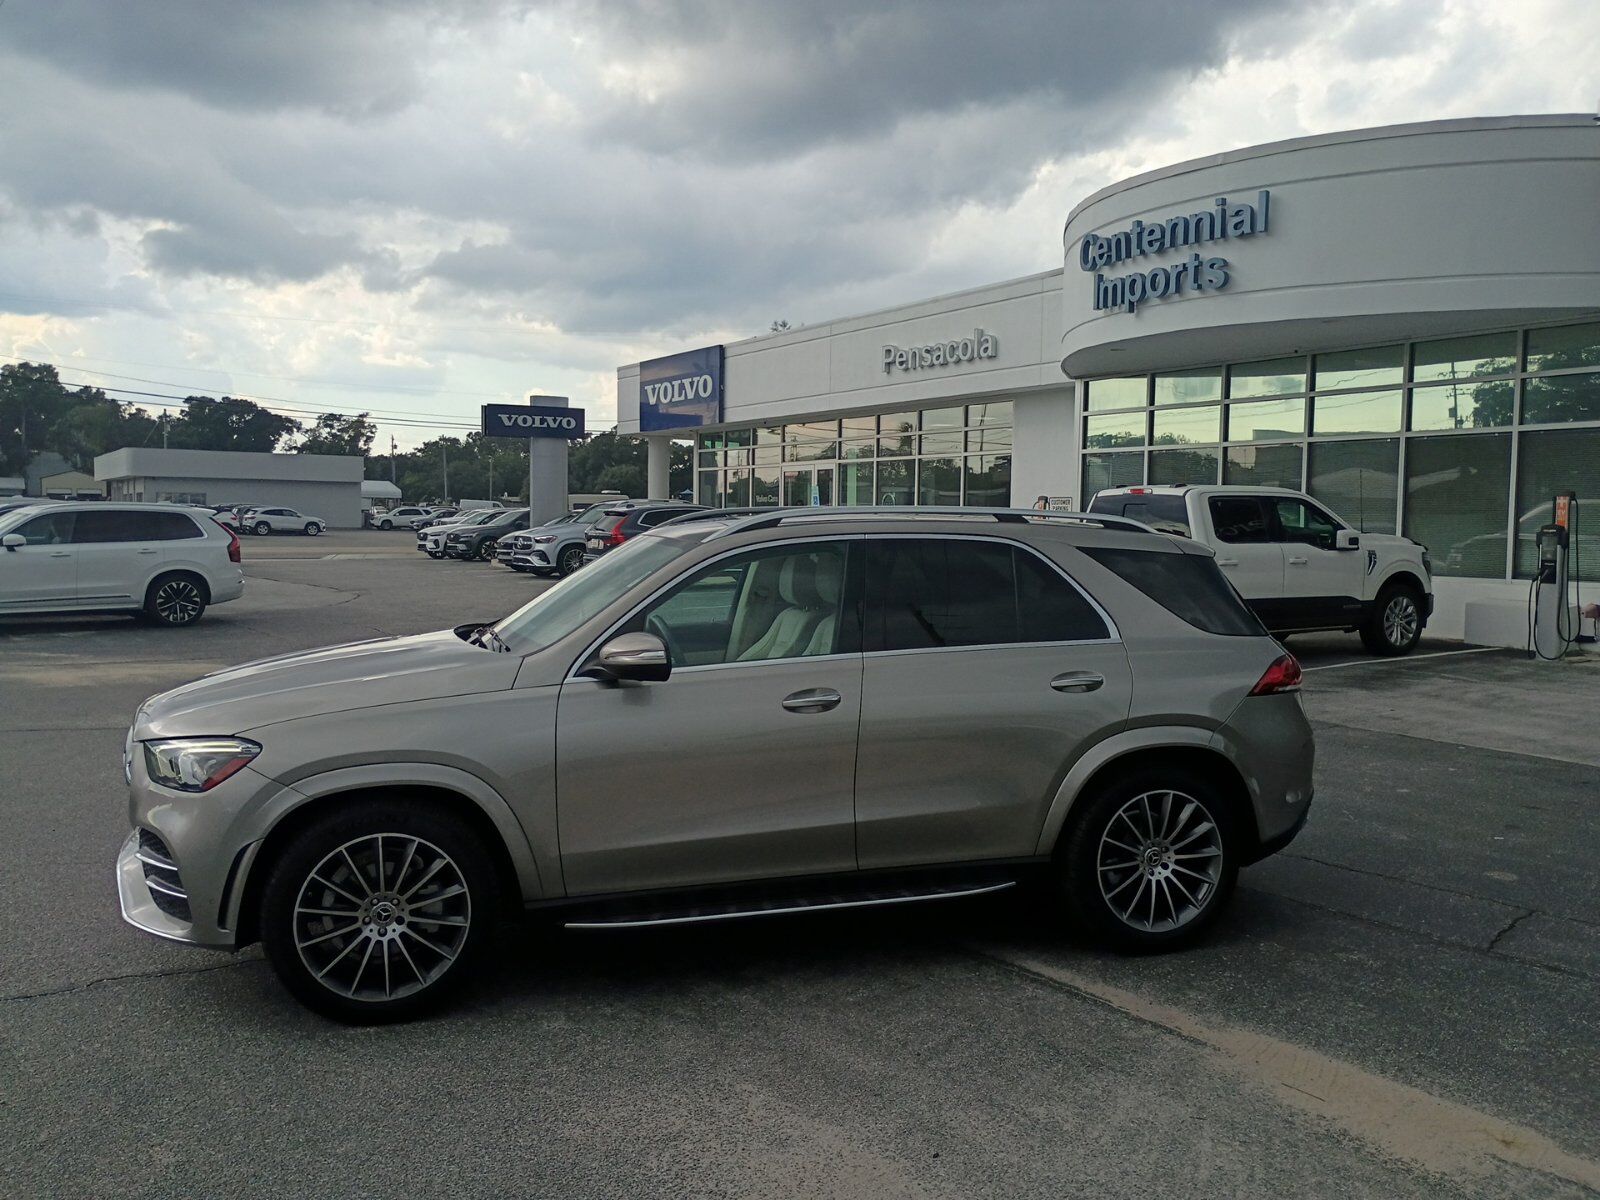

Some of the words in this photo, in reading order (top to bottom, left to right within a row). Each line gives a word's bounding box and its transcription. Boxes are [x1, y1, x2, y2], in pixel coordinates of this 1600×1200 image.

[1080, 190, 1270, 271] Centennial
[1093, 253, 1229, 313] Imports
[882, 328, 998, 374] Pensacola
[645, 374, 713, 405] VOLVO
[498, 413, 577, 430] VOLVO
